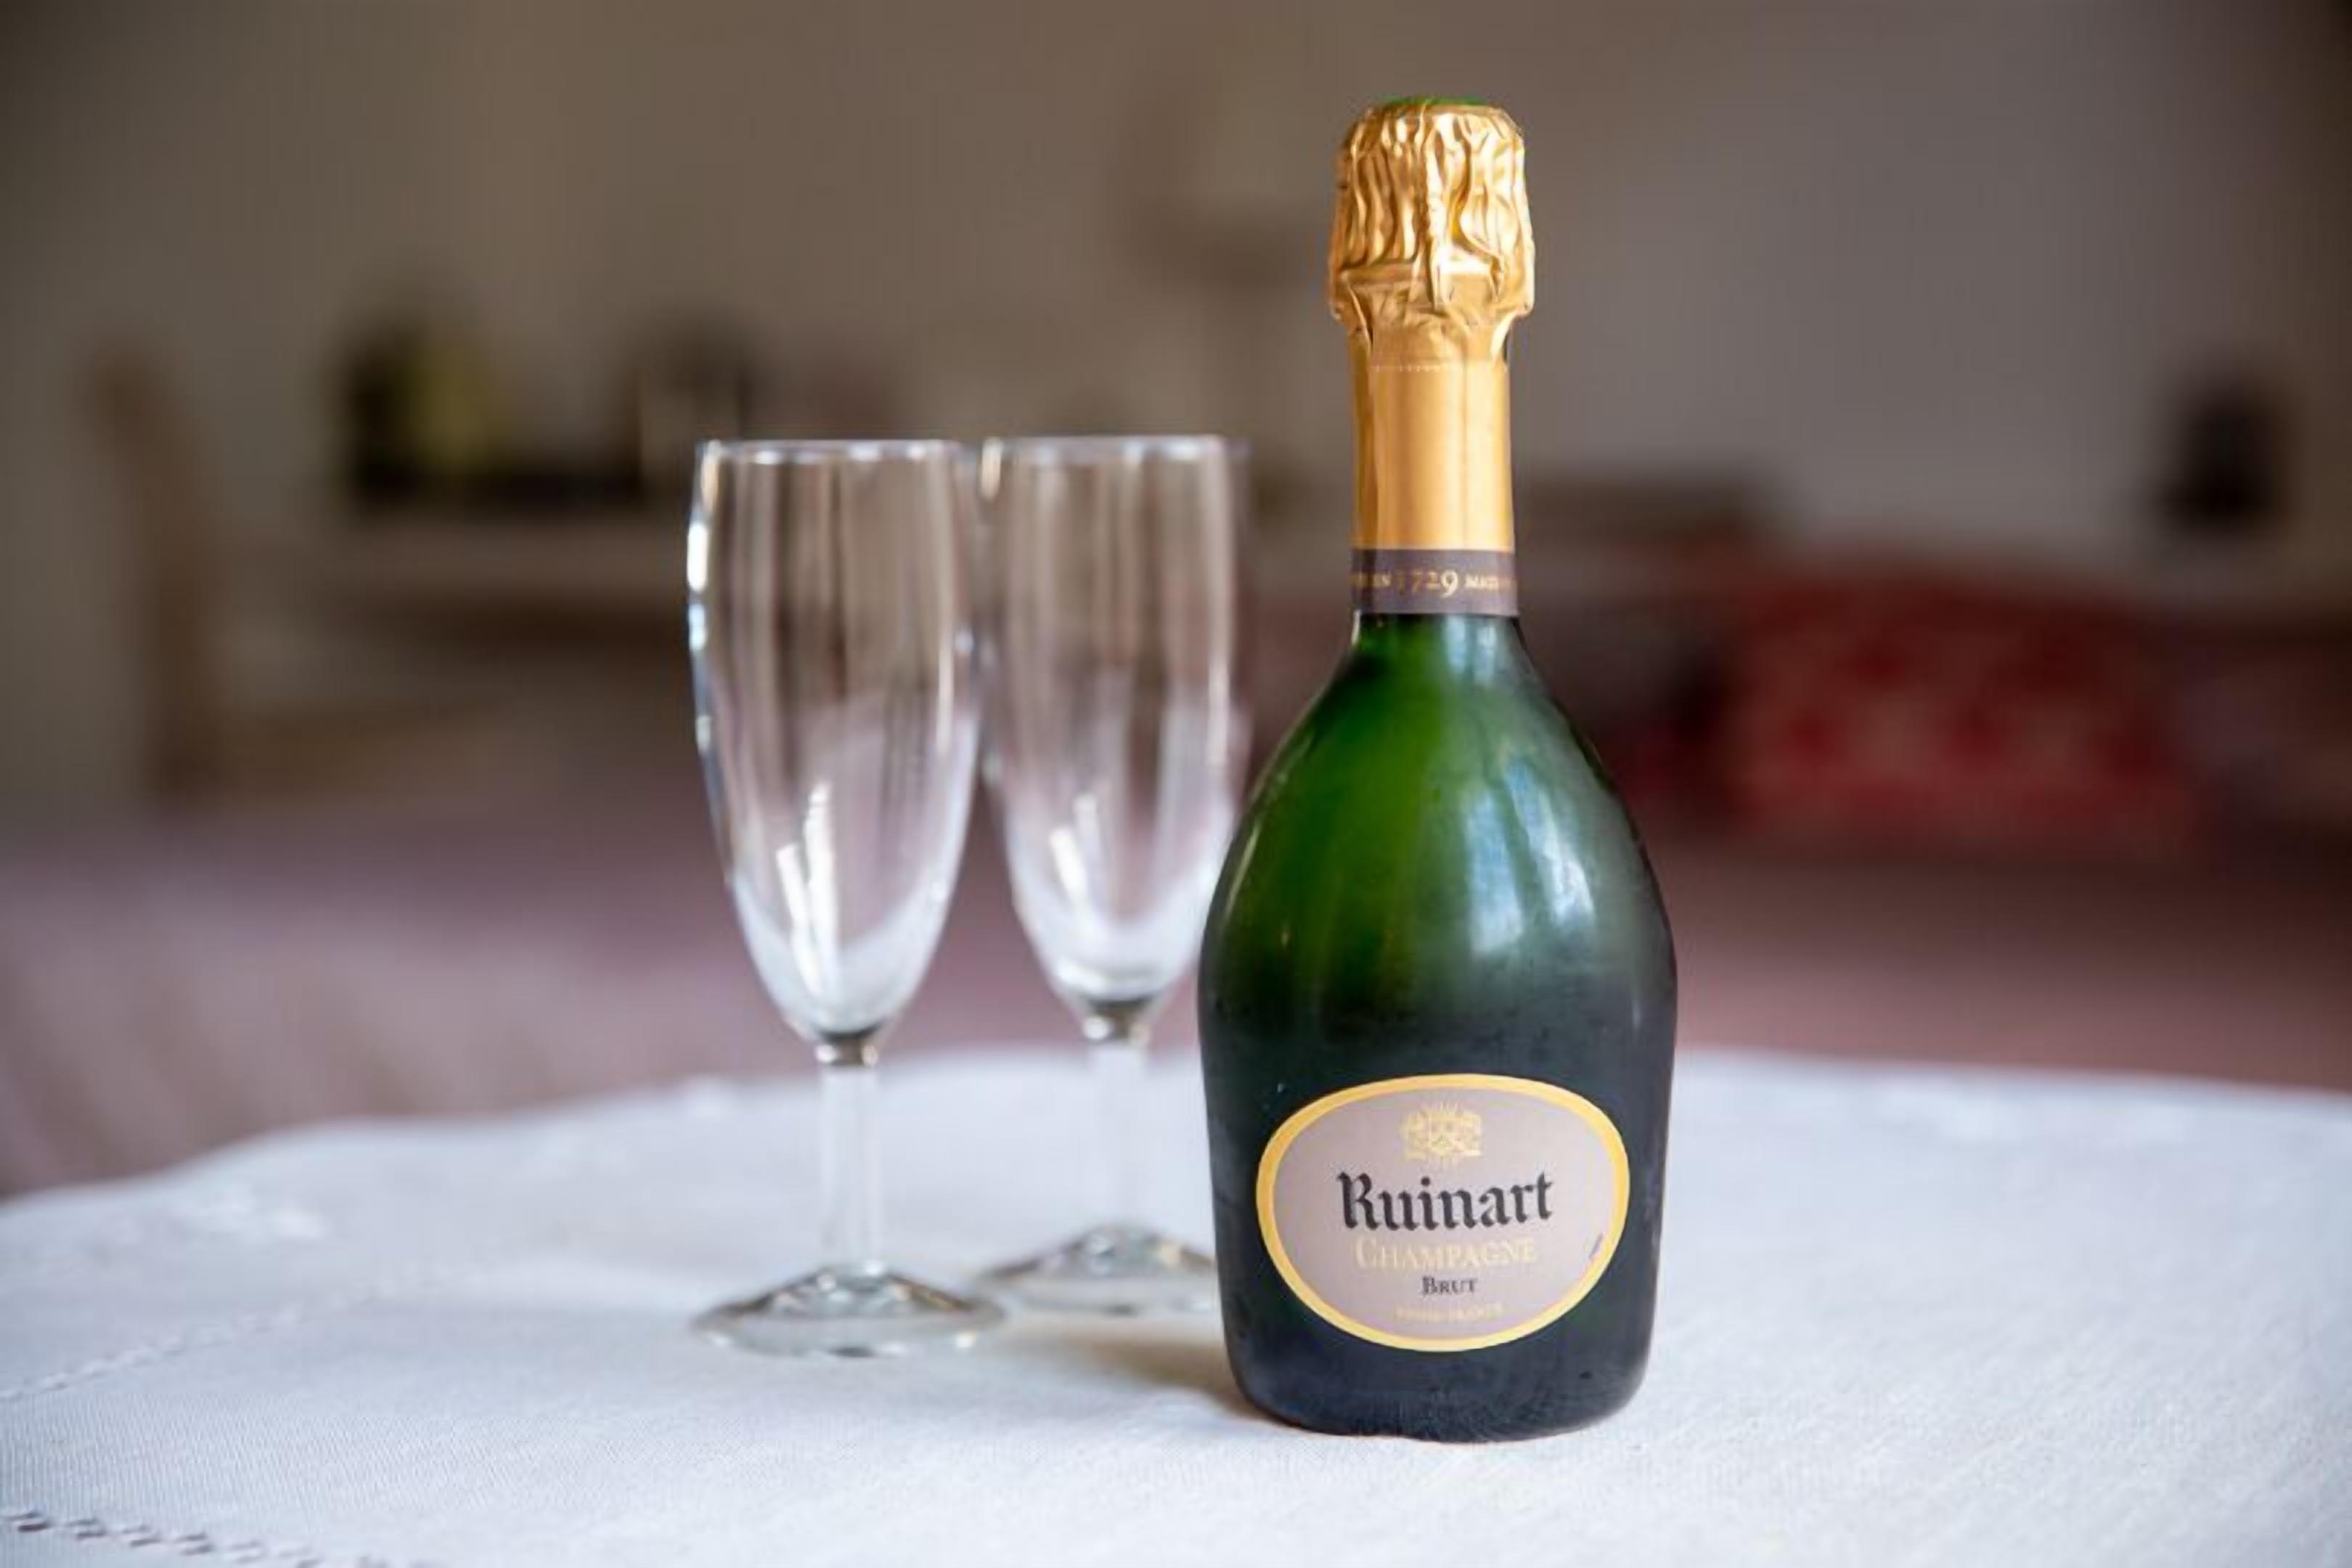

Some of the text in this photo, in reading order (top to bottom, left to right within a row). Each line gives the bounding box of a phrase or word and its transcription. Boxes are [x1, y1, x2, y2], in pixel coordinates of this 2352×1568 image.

[1398, 569, 1458, 598] 1729
[1338, 1172, 1553, 1231] Ruinart
[1355, 1236, 1535, 1270] CHAMPAGNE
[1421, 1275, 1478, 1295] BRUT
